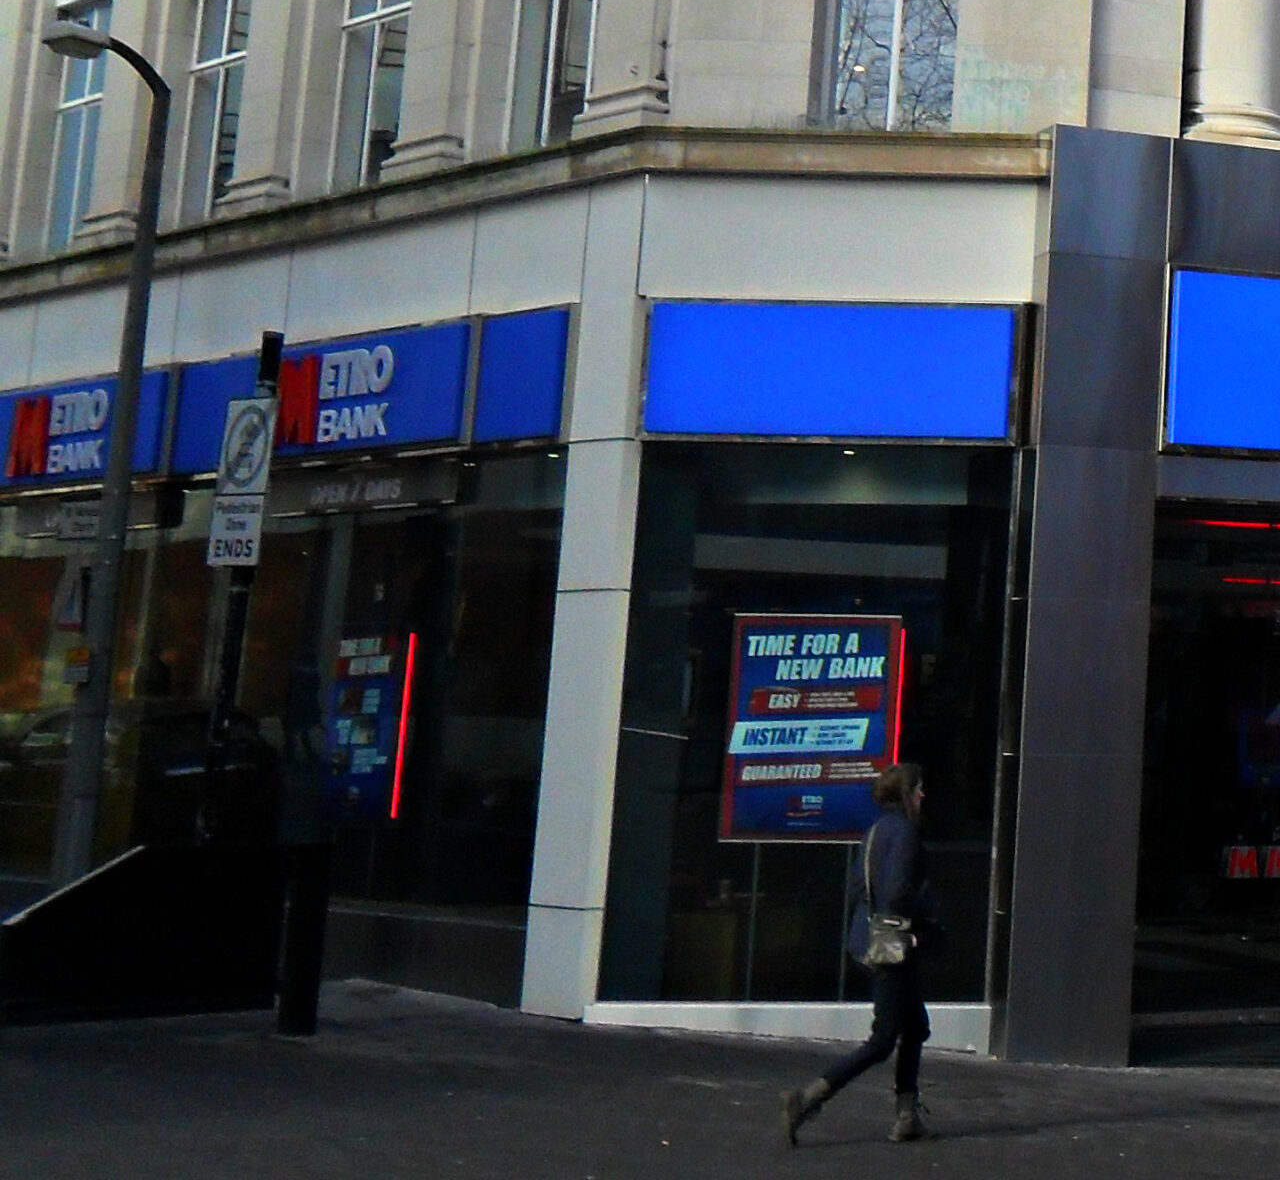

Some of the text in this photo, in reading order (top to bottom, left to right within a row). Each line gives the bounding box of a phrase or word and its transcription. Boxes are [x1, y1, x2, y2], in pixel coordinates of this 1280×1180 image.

[277, 345, 394, 447] METRO
[6, 389, 109, 478] METRO
[317, 402, 389, 444] BANK
[47, 439, 104, 474] BANK
[214, 539, 254, 558] ENDS
[747, 632, 861, 657] TIME FOR A
[775, 656, 886, 681] NEW BANK
[768, 693, 802, 709] EASY
[742, 727, 808, 746] INSTANT
[741, 764, 822, 780] GUARANTEED
